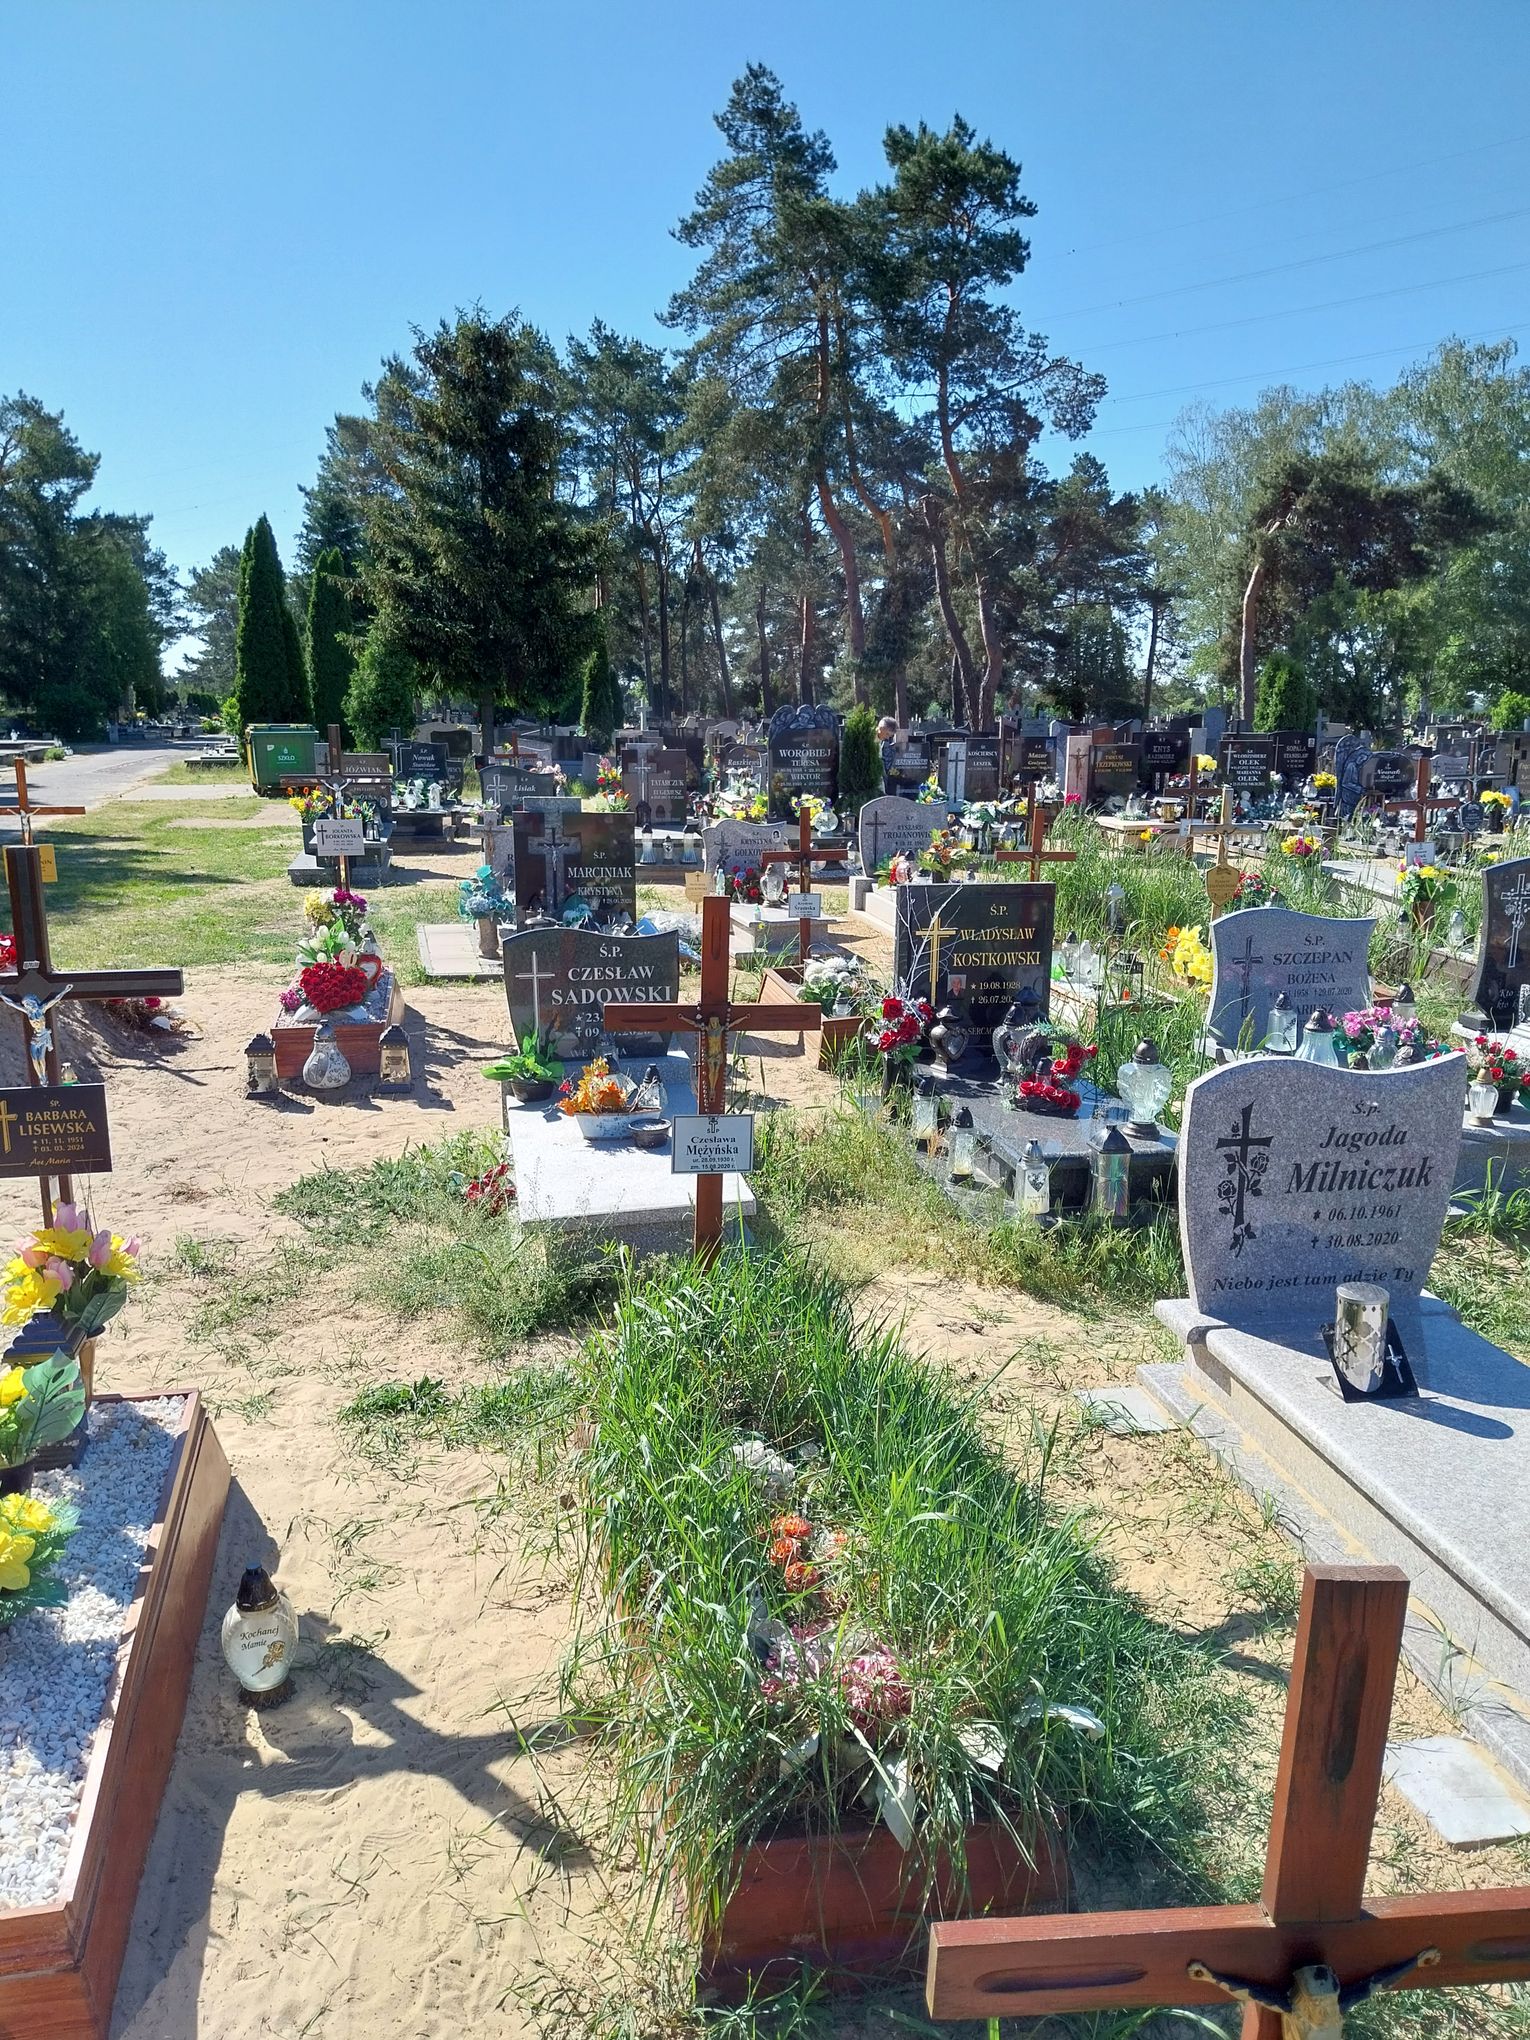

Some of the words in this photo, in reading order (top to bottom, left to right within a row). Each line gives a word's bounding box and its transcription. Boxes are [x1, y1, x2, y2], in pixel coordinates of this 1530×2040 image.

[779, 748, 832, 758] WOROBIEJ
[568, 866, 632, 878] MARCINIAK
[578, 886, 624, 896] KRYSTYNA
[960, 928, 1036, 941] WŁADYSŁAW
[599, 944, 623, 958] Ś.P.
[952, 951, 1041, 967] KOSTKOWSKI
[1272, 951, 1354, 966] SZCZEPAN
[568, 965, 655, 982] CZESŁAW
[1287, 972, 1336, 985] BOŻENA
[552, 986, 672, 1006] SADOWSKI
[25, 1109, 88, 1122] BARBARA
[20, 1122, 96, 1136] LISEWSKA
[690, 1136, 736, 1144] Czesława
[1319, 1124, 1408, 1153] Jagoda
[686, 1144, 739, 1158] Mężyńska
[1284, 1156, 1435, 1194] Milniczuk
[1328, 1204, 1401, 1222] 06.10.1961
[1325, 1231, 1400, 1250] 30.08.2020
[1212, 1276, 1264, 1292] Niebo
[1266, 1273, 1302, 1292] jest
[1304, 1271, 1338, 1286] tam
[1392, 1266, 1415, 1282] Ty
[240, 1626, 280, 1641] Kochanej
[241, 1639, 268, 1652] Mamie
